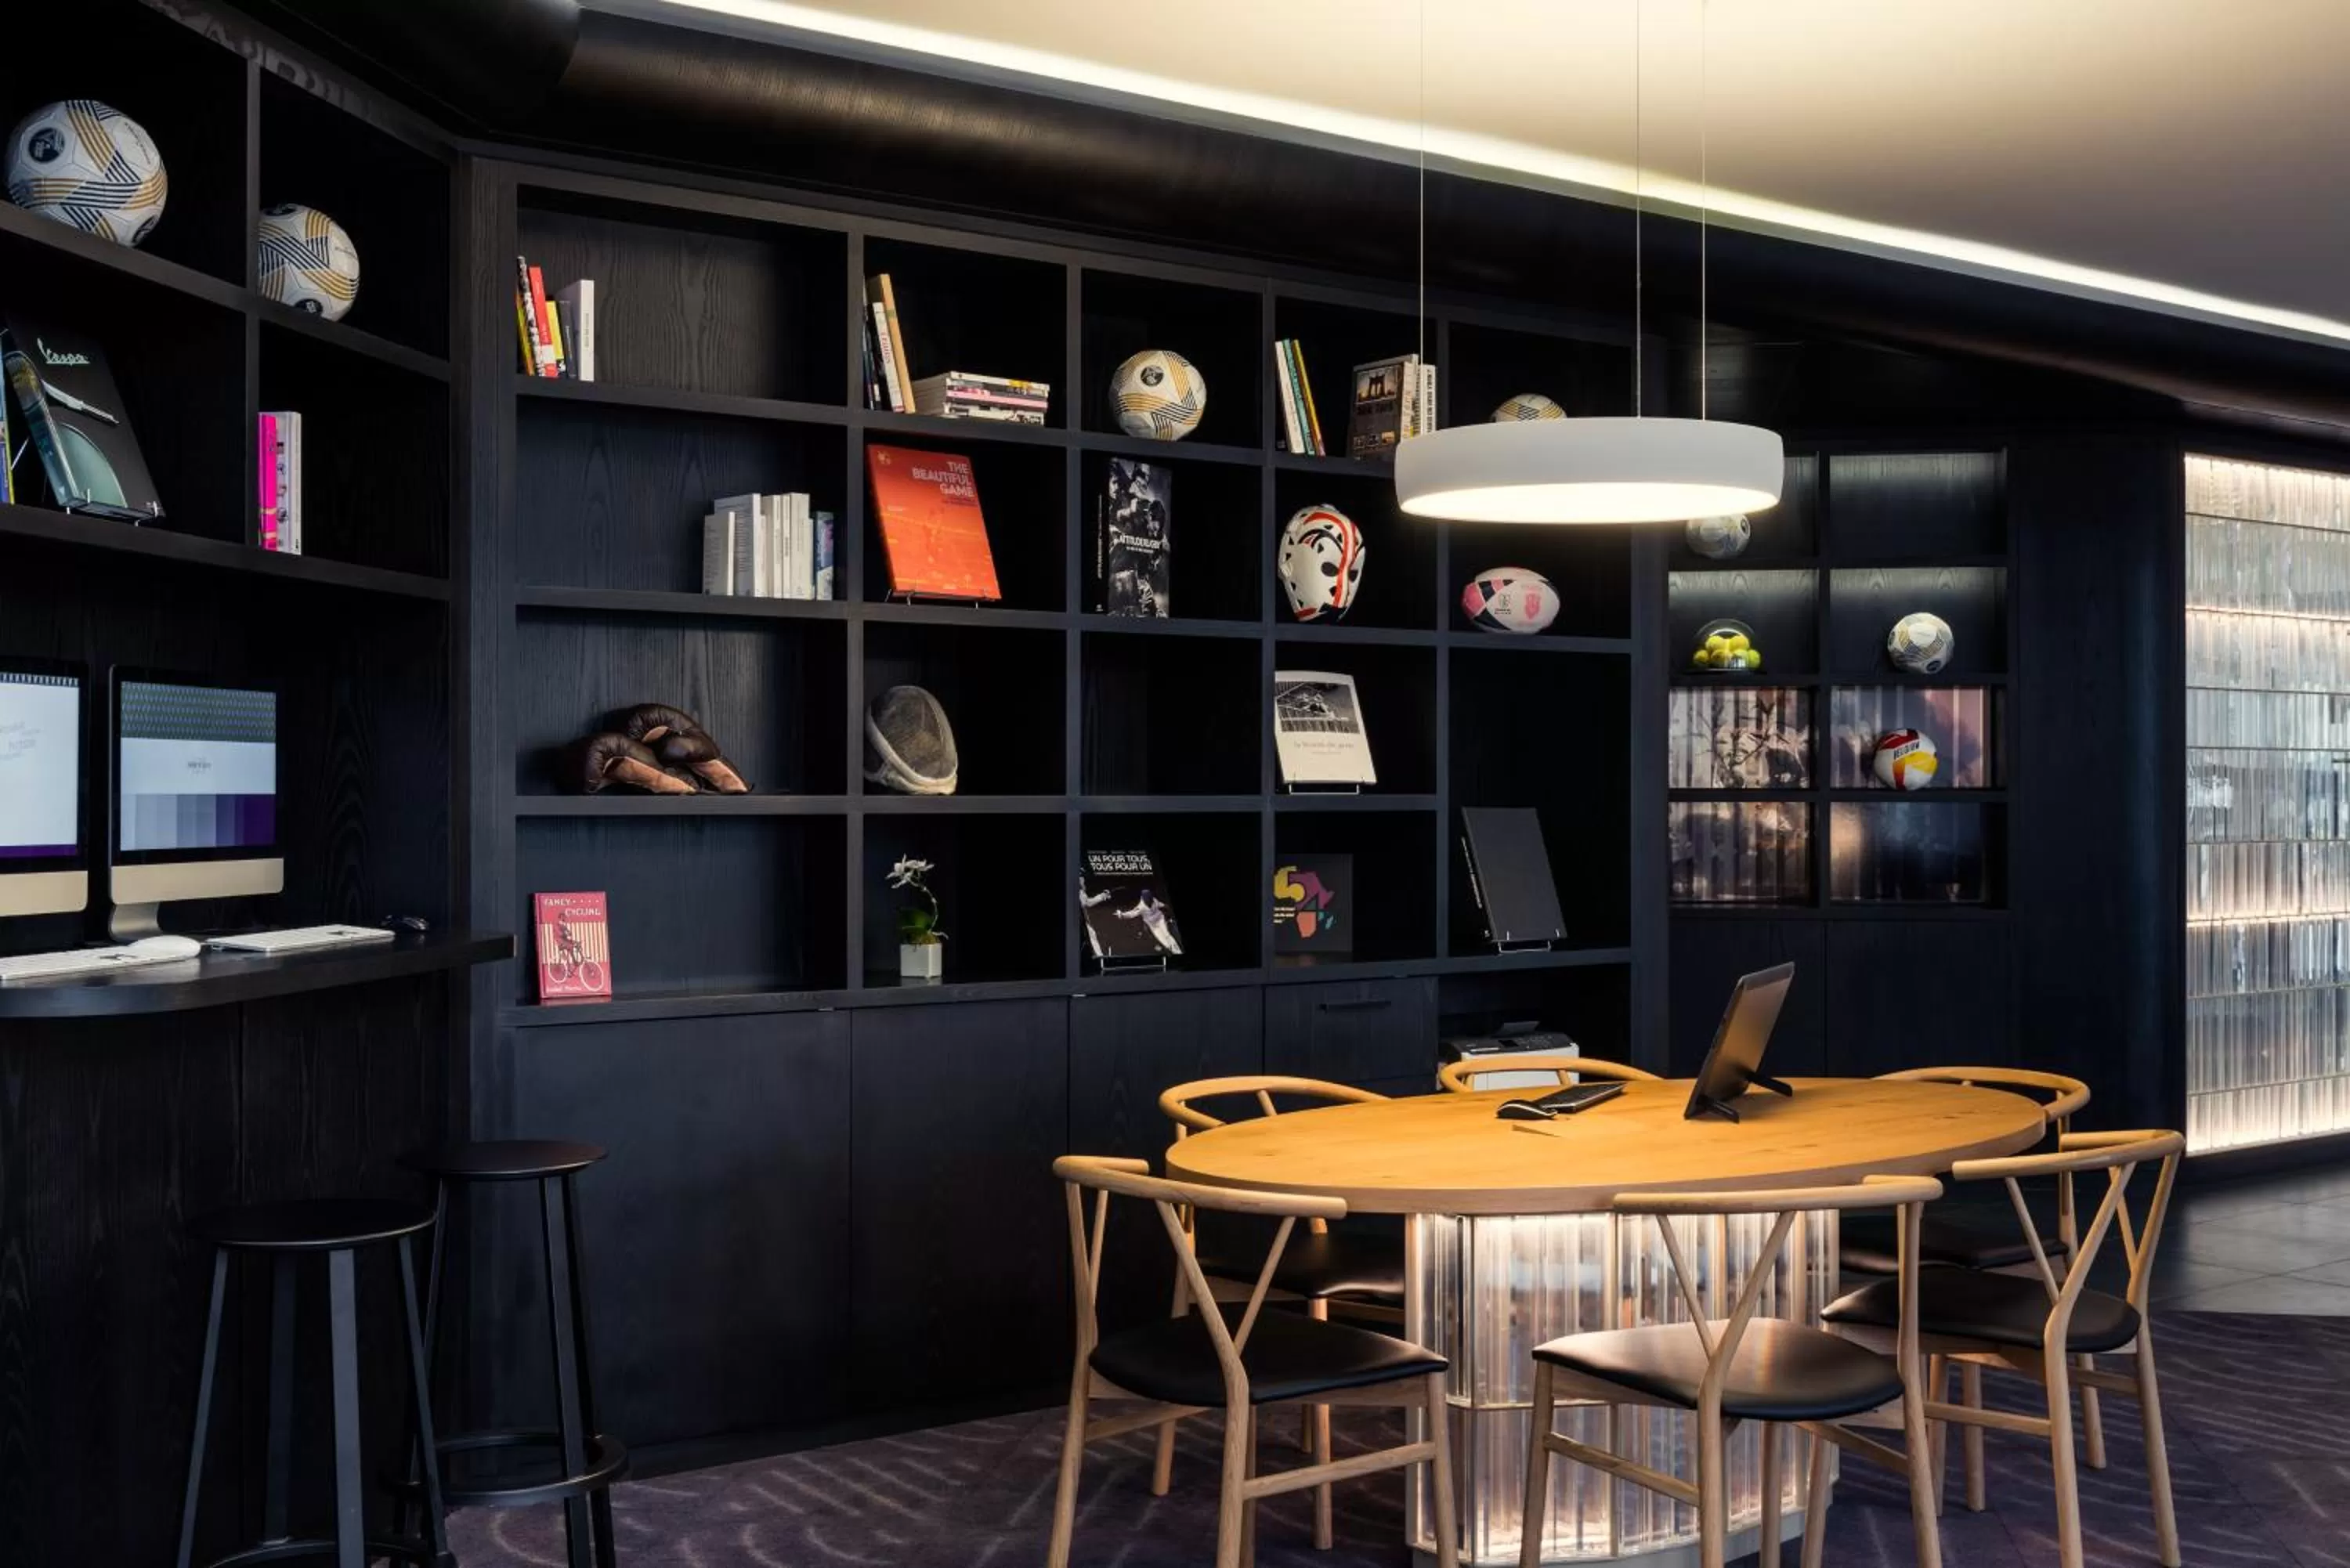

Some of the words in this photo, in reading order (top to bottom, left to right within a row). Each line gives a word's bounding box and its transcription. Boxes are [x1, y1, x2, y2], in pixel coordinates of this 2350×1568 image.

[37, 338, 90, 366] Vespa
[946, 461, 969, 474] THE
[911, 468, 972, 486] BEAUTIFUL
[940, 482, 975, 497] GAME
[1090, 862, 1113, 871] TOUS
[1115, 862, 1138, 871] POUR
